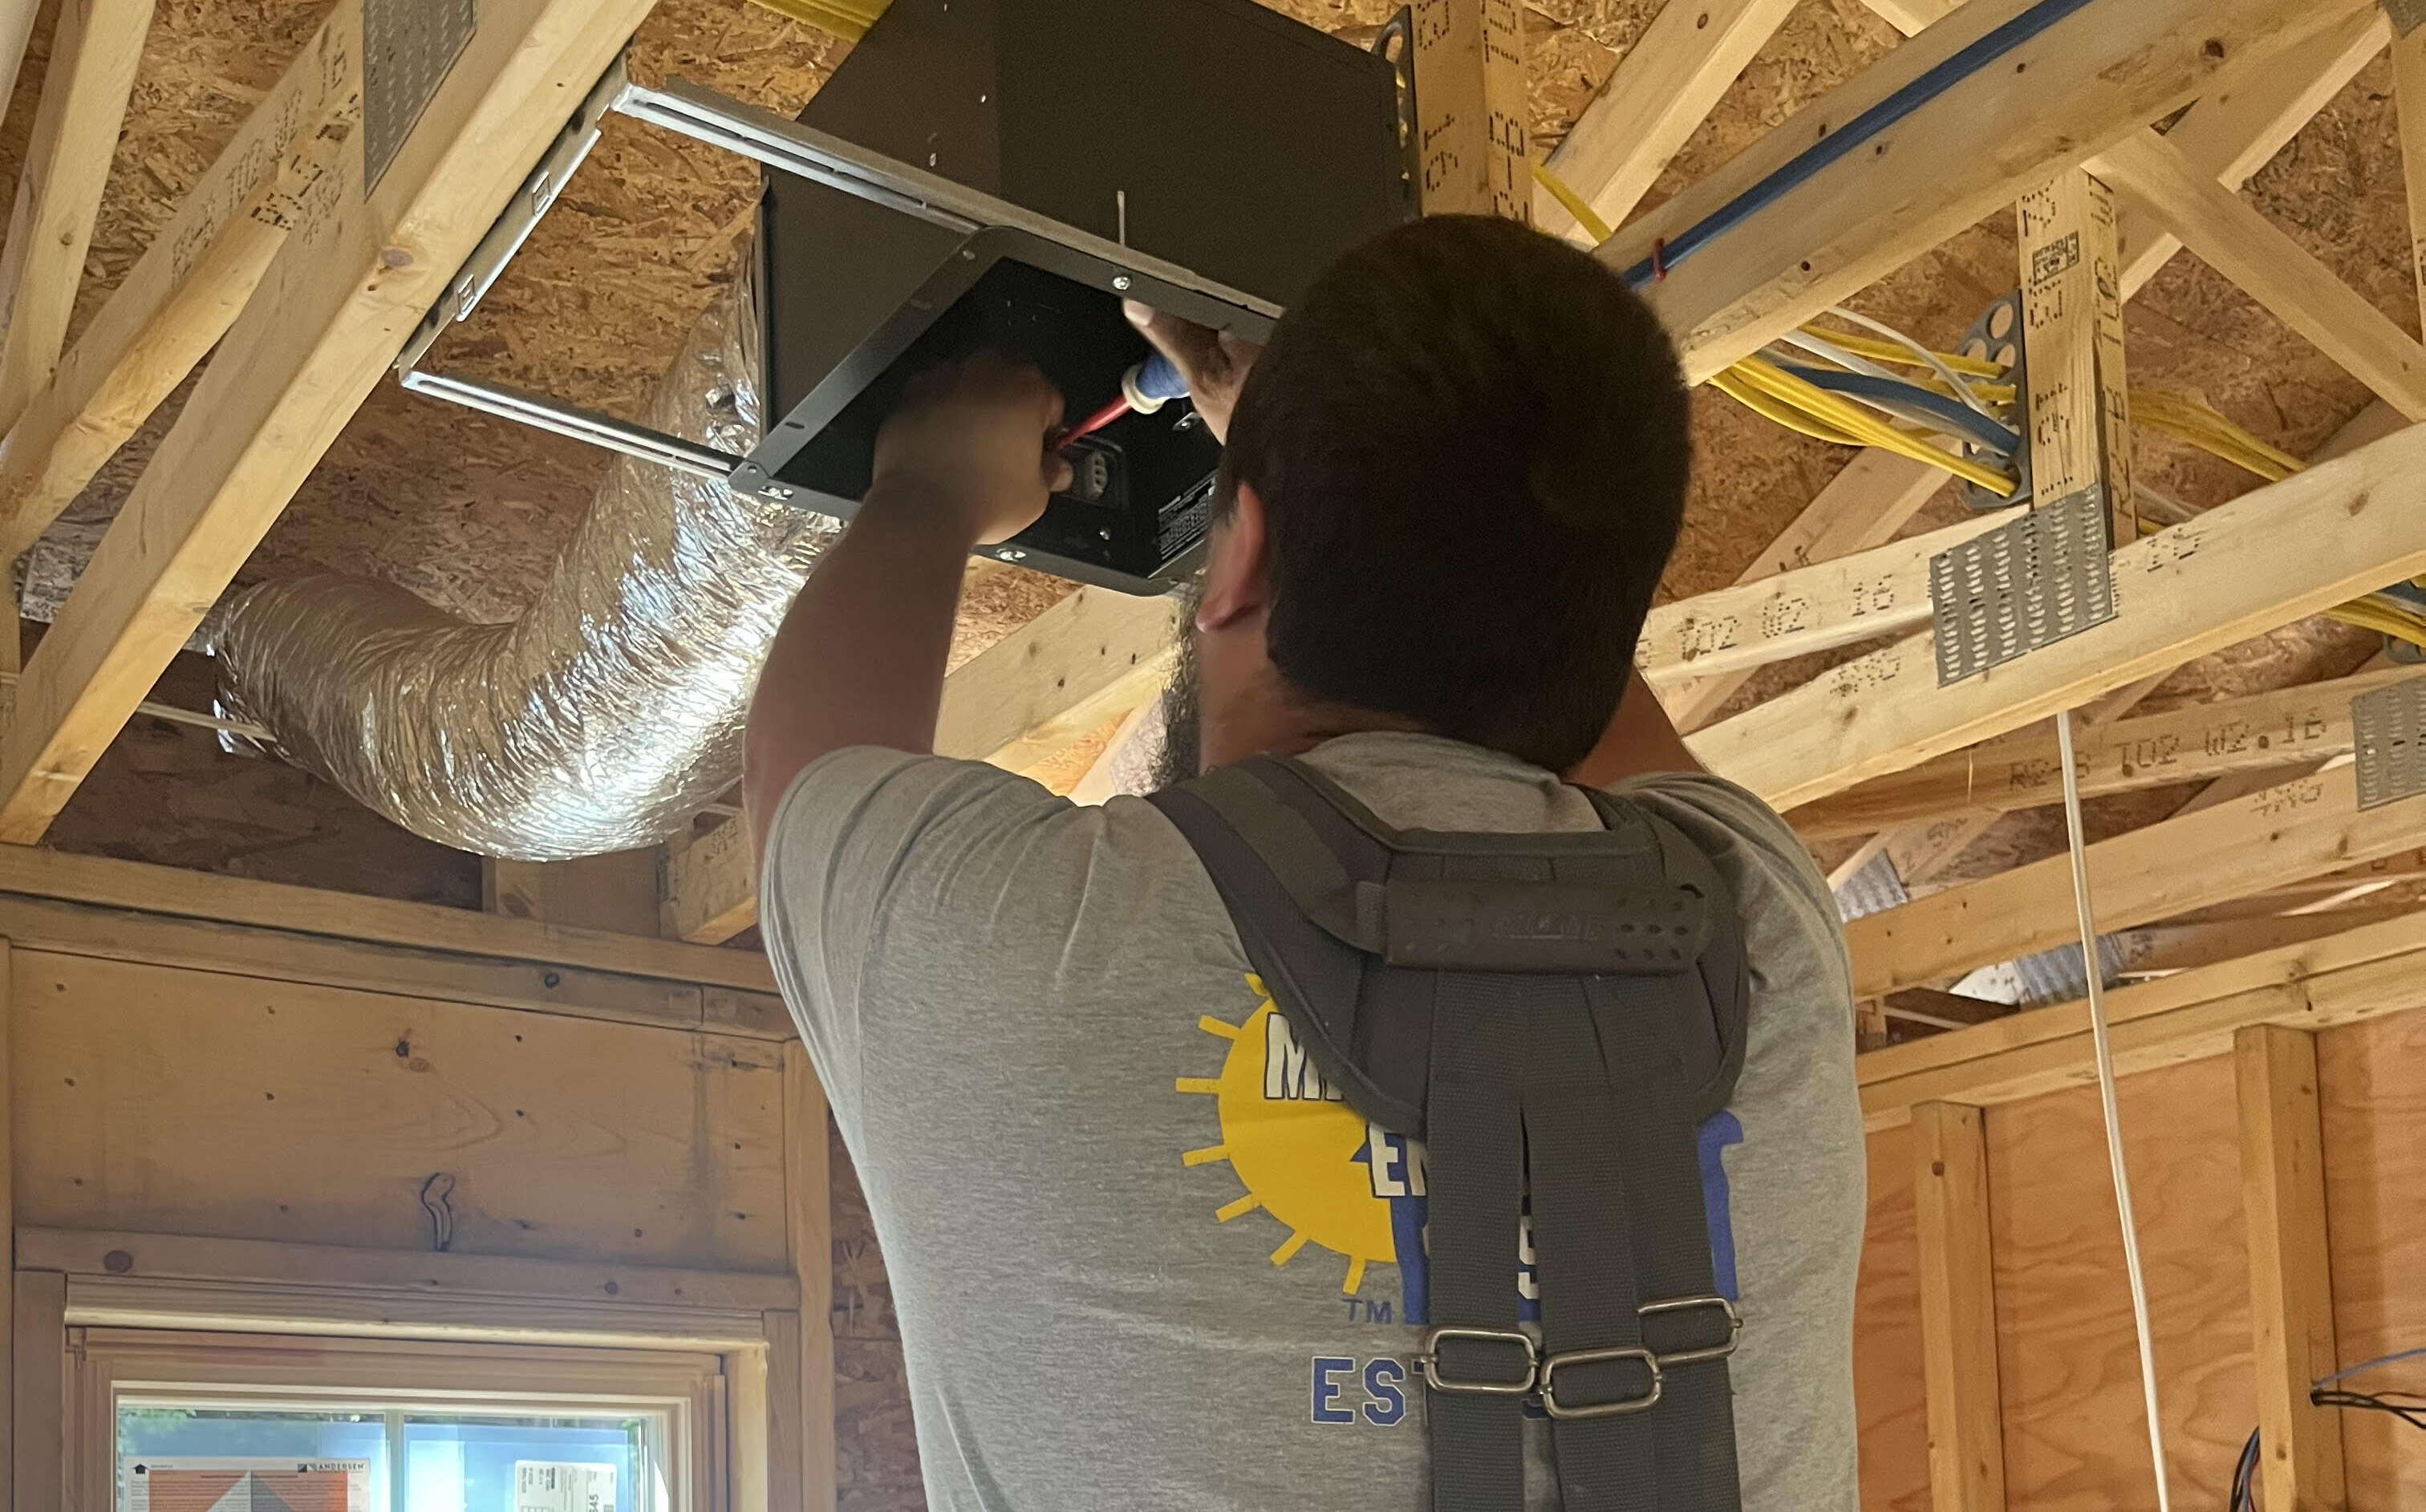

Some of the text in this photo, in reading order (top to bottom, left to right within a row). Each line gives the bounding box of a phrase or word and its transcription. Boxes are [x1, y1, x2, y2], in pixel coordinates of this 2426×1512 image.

[1851, 574, 1896, 617] 16
[2114, 733, 2181, 777] T02
[2282, 707, 2328, 744] 16
[1341, 1298, 1393, 1324] TM
[318, 1462, 364, 1470] ANDERSEN
